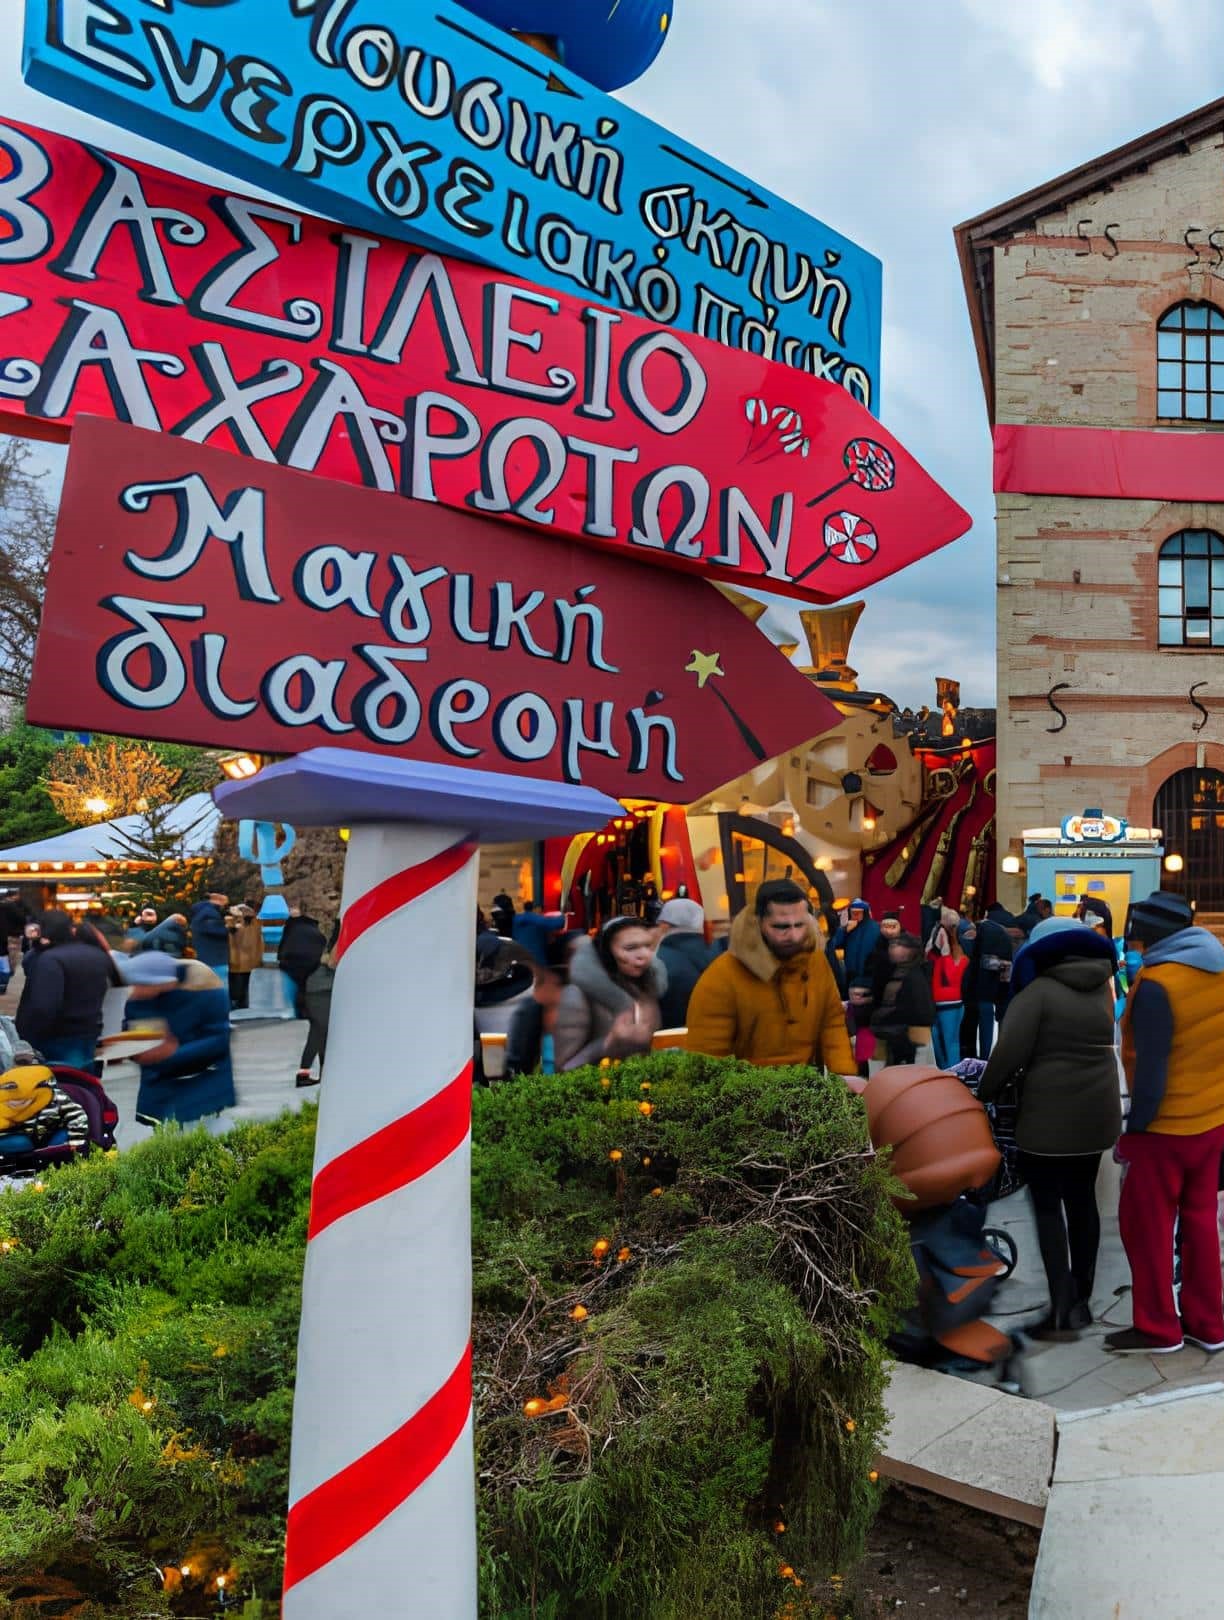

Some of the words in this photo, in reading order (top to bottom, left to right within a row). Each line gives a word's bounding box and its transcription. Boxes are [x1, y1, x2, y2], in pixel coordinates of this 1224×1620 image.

[641, 184, 853, 346] σκηνή
[118, 472, 622, 674] Μαγική
[96, 594, 685, 786] διαδρομή
